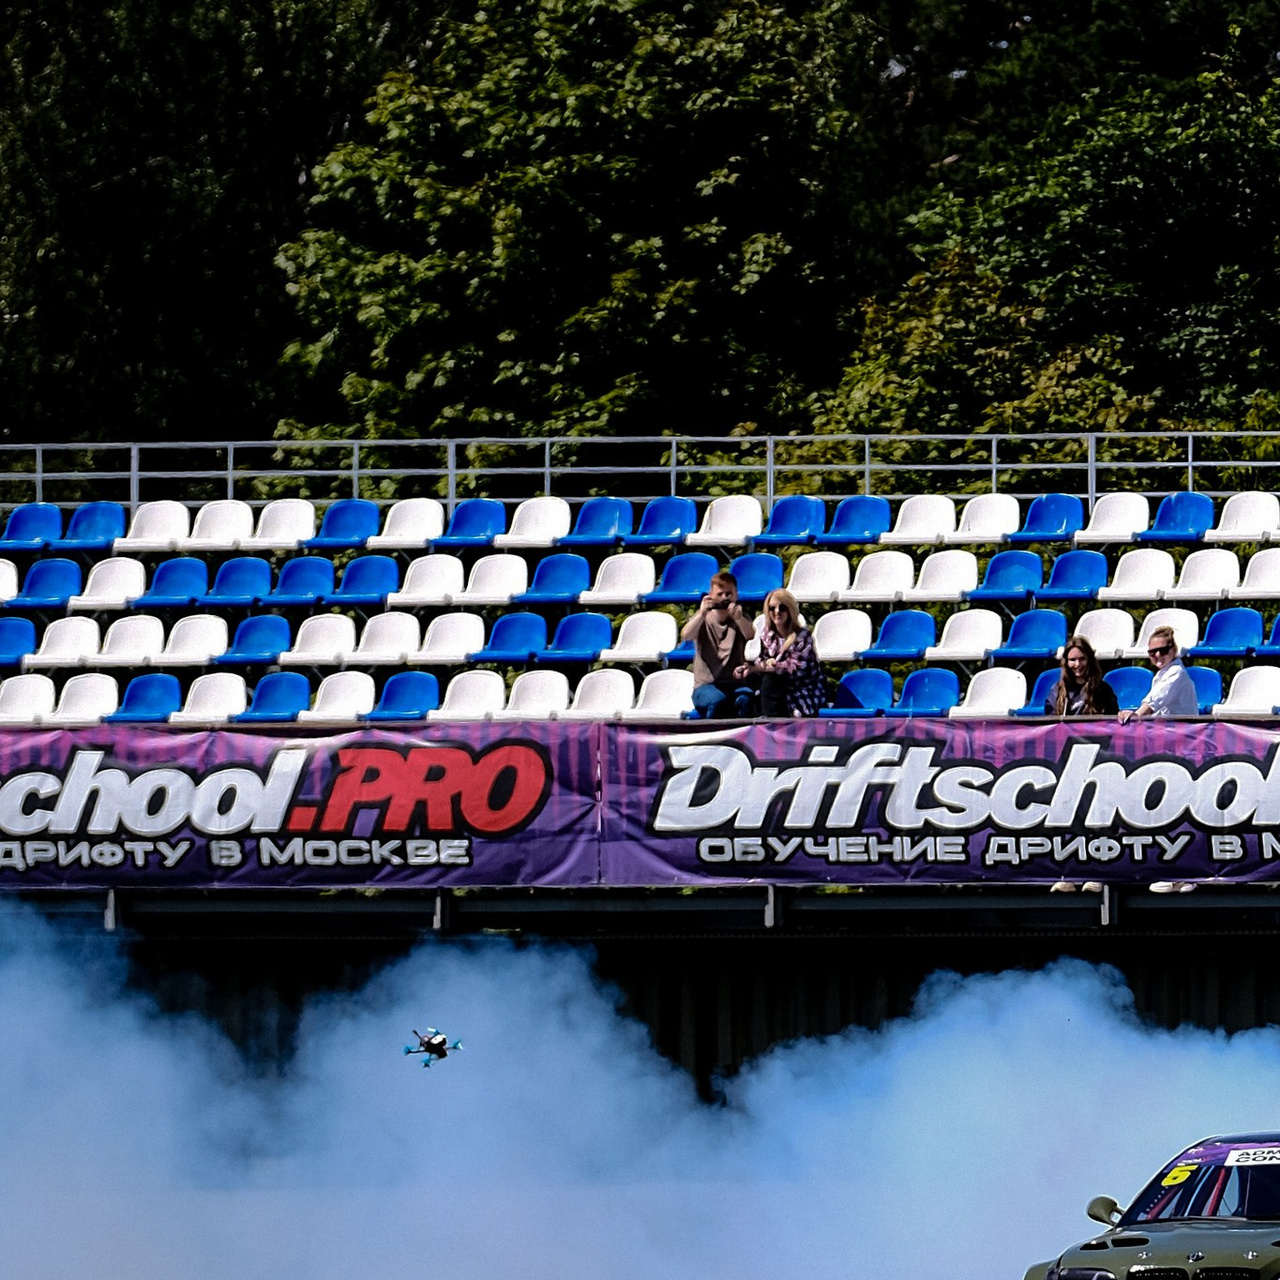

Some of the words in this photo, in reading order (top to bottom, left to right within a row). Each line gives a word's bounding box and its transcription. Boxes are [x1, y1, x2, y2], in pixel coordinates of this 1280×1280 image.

[212, 840, 242, 865] В
[260, 837, 470, 865] МОСКВЕ
[700, 836, 966, 862] ОБУЧЕНИЕ
[986, 836, 1191, 865] ДРИФТУ
[1212, 835, 1244, 860] В
